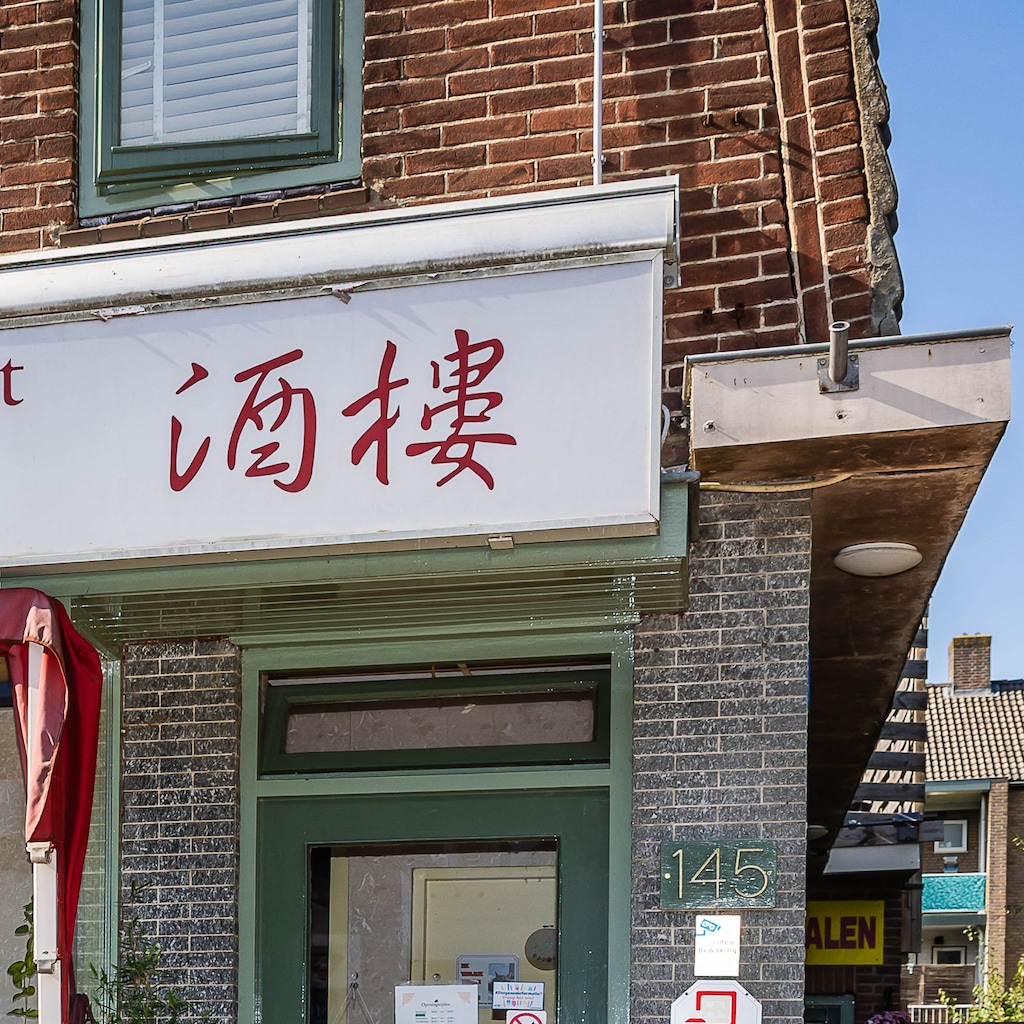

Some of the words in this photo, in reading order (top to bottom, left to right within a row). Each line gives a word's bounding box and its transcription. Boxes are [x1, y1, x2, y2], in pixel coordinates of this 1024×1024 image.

[169, 329, 517, 493] 酒樓
[672, 847, 769, 899] 145
[805, 916, 876, 950] ALEN
